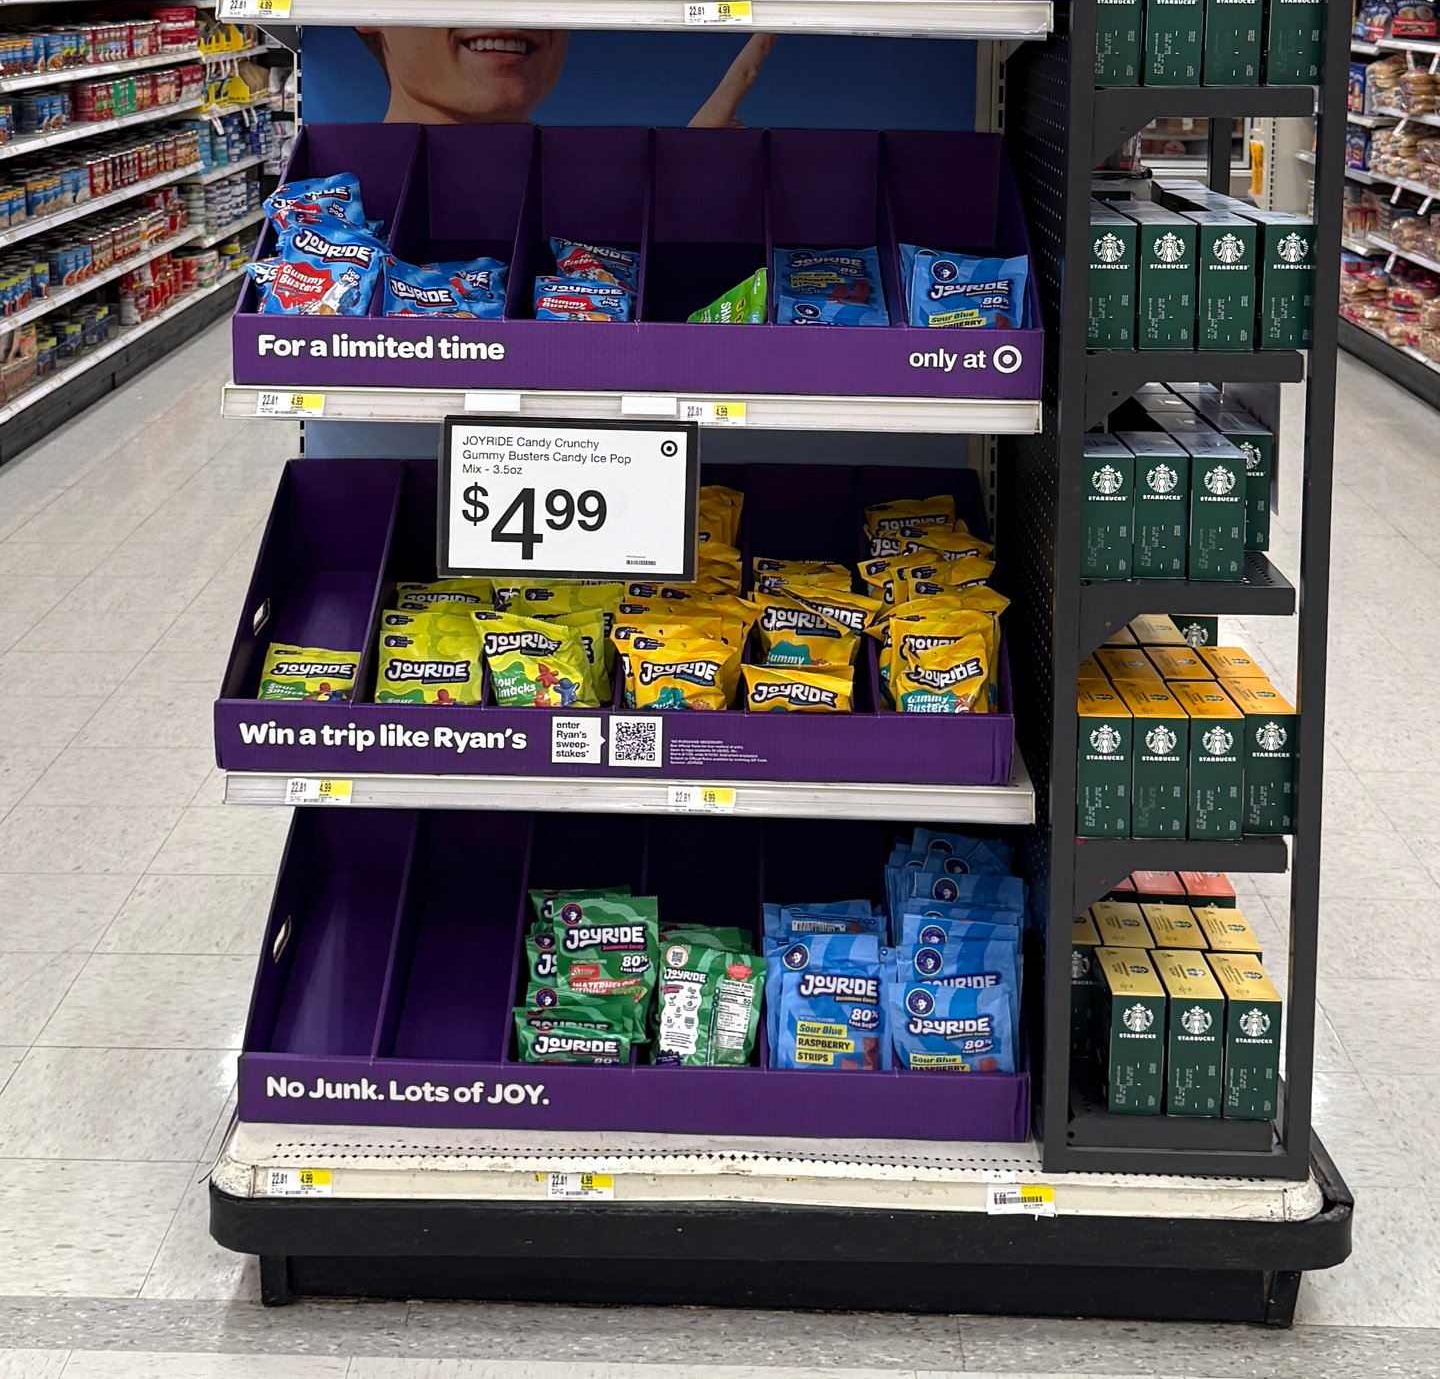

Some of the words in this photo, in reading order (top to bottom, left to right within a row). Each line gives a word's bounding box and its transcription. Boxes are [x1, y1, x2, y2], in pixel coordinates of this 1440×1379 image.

[295, 229, 373, 262] JOYRIDE
[279, 274, 324, 294] Busters
[283, 264, 326, 287] Gummy
[391, 280, 454, 303] JOYRIDE
[544, 285, 624, 295] JOYRIDE
[930, 280, 1010, 299] JOYRIDE
[931, 313, 953, 323] Sour
[258, 334, 306, 358] For
[310, 339, 329, 358] a
[332, 334, 434, 360] limited
[438, 336, 506, 361] time
[909, 348, 958, 374] only
[963, 350, 987, 369] at
[462, 436, 514, 447] JOYRIDE
[516, 437, 552, 450] Candy
[554, 438, 600, 451] Crunchy
[462, 450, 506, 463] Gummy
[508, 451, 550, 462] Busters
[552, 452, 588, 465] Candy
[590, 453, 607, 463] Ice
[610, 454, 632, 466] Pop
[462, 464, 482, 474] Mix
[493, 464, 523, 475] 3.5oz
[485, 634, 560, 654] JOYRIDE
[274, 664, 356, 675] JOYRIDE
[387, 661, 468, 679] JOYRIDE
[641, 662, 719, 683] JOYRIDE
[753, 683, 836, 705] JOYRIDE
[556, 721, 581, 729] enter
[239, 721, 295, 745] Win
[299, 728, 317, 745] a
[320, 723, 376, 752] trip
[379, 723, 430, 748] like
[433, 726, 528, 755] Ryan’s
[556, 730, 587, 740] Ryan's
[556, 741, 590, 749] sweep-
[565, 926, 645, 950] JOYRIDE
[663, 968, 707, 983] JOYRIDE
[800, 974, 878, 996] JOYRIDE
[799, 1024, 820, 1034] Sour
[821, 1025, 843, 1036] Blue
[909, 1017, 991, 1034] JOYRIDE
[534, 1036, 619, 1053] JOYRIDE
[798, 1038, 851, 1050] RASPBERRY
[797, 1052, 829, 1062] STRIPS
[912, 1055, 934, 1063] Sour
[266, 1076, 305, 1098] No
[309, 1077, 385, 1101] Junk.
[389, 1080, 449, 1103] Lots
[453, 1081, 484, 1104] of
[486, 1083, 550, 1106] JOY.
